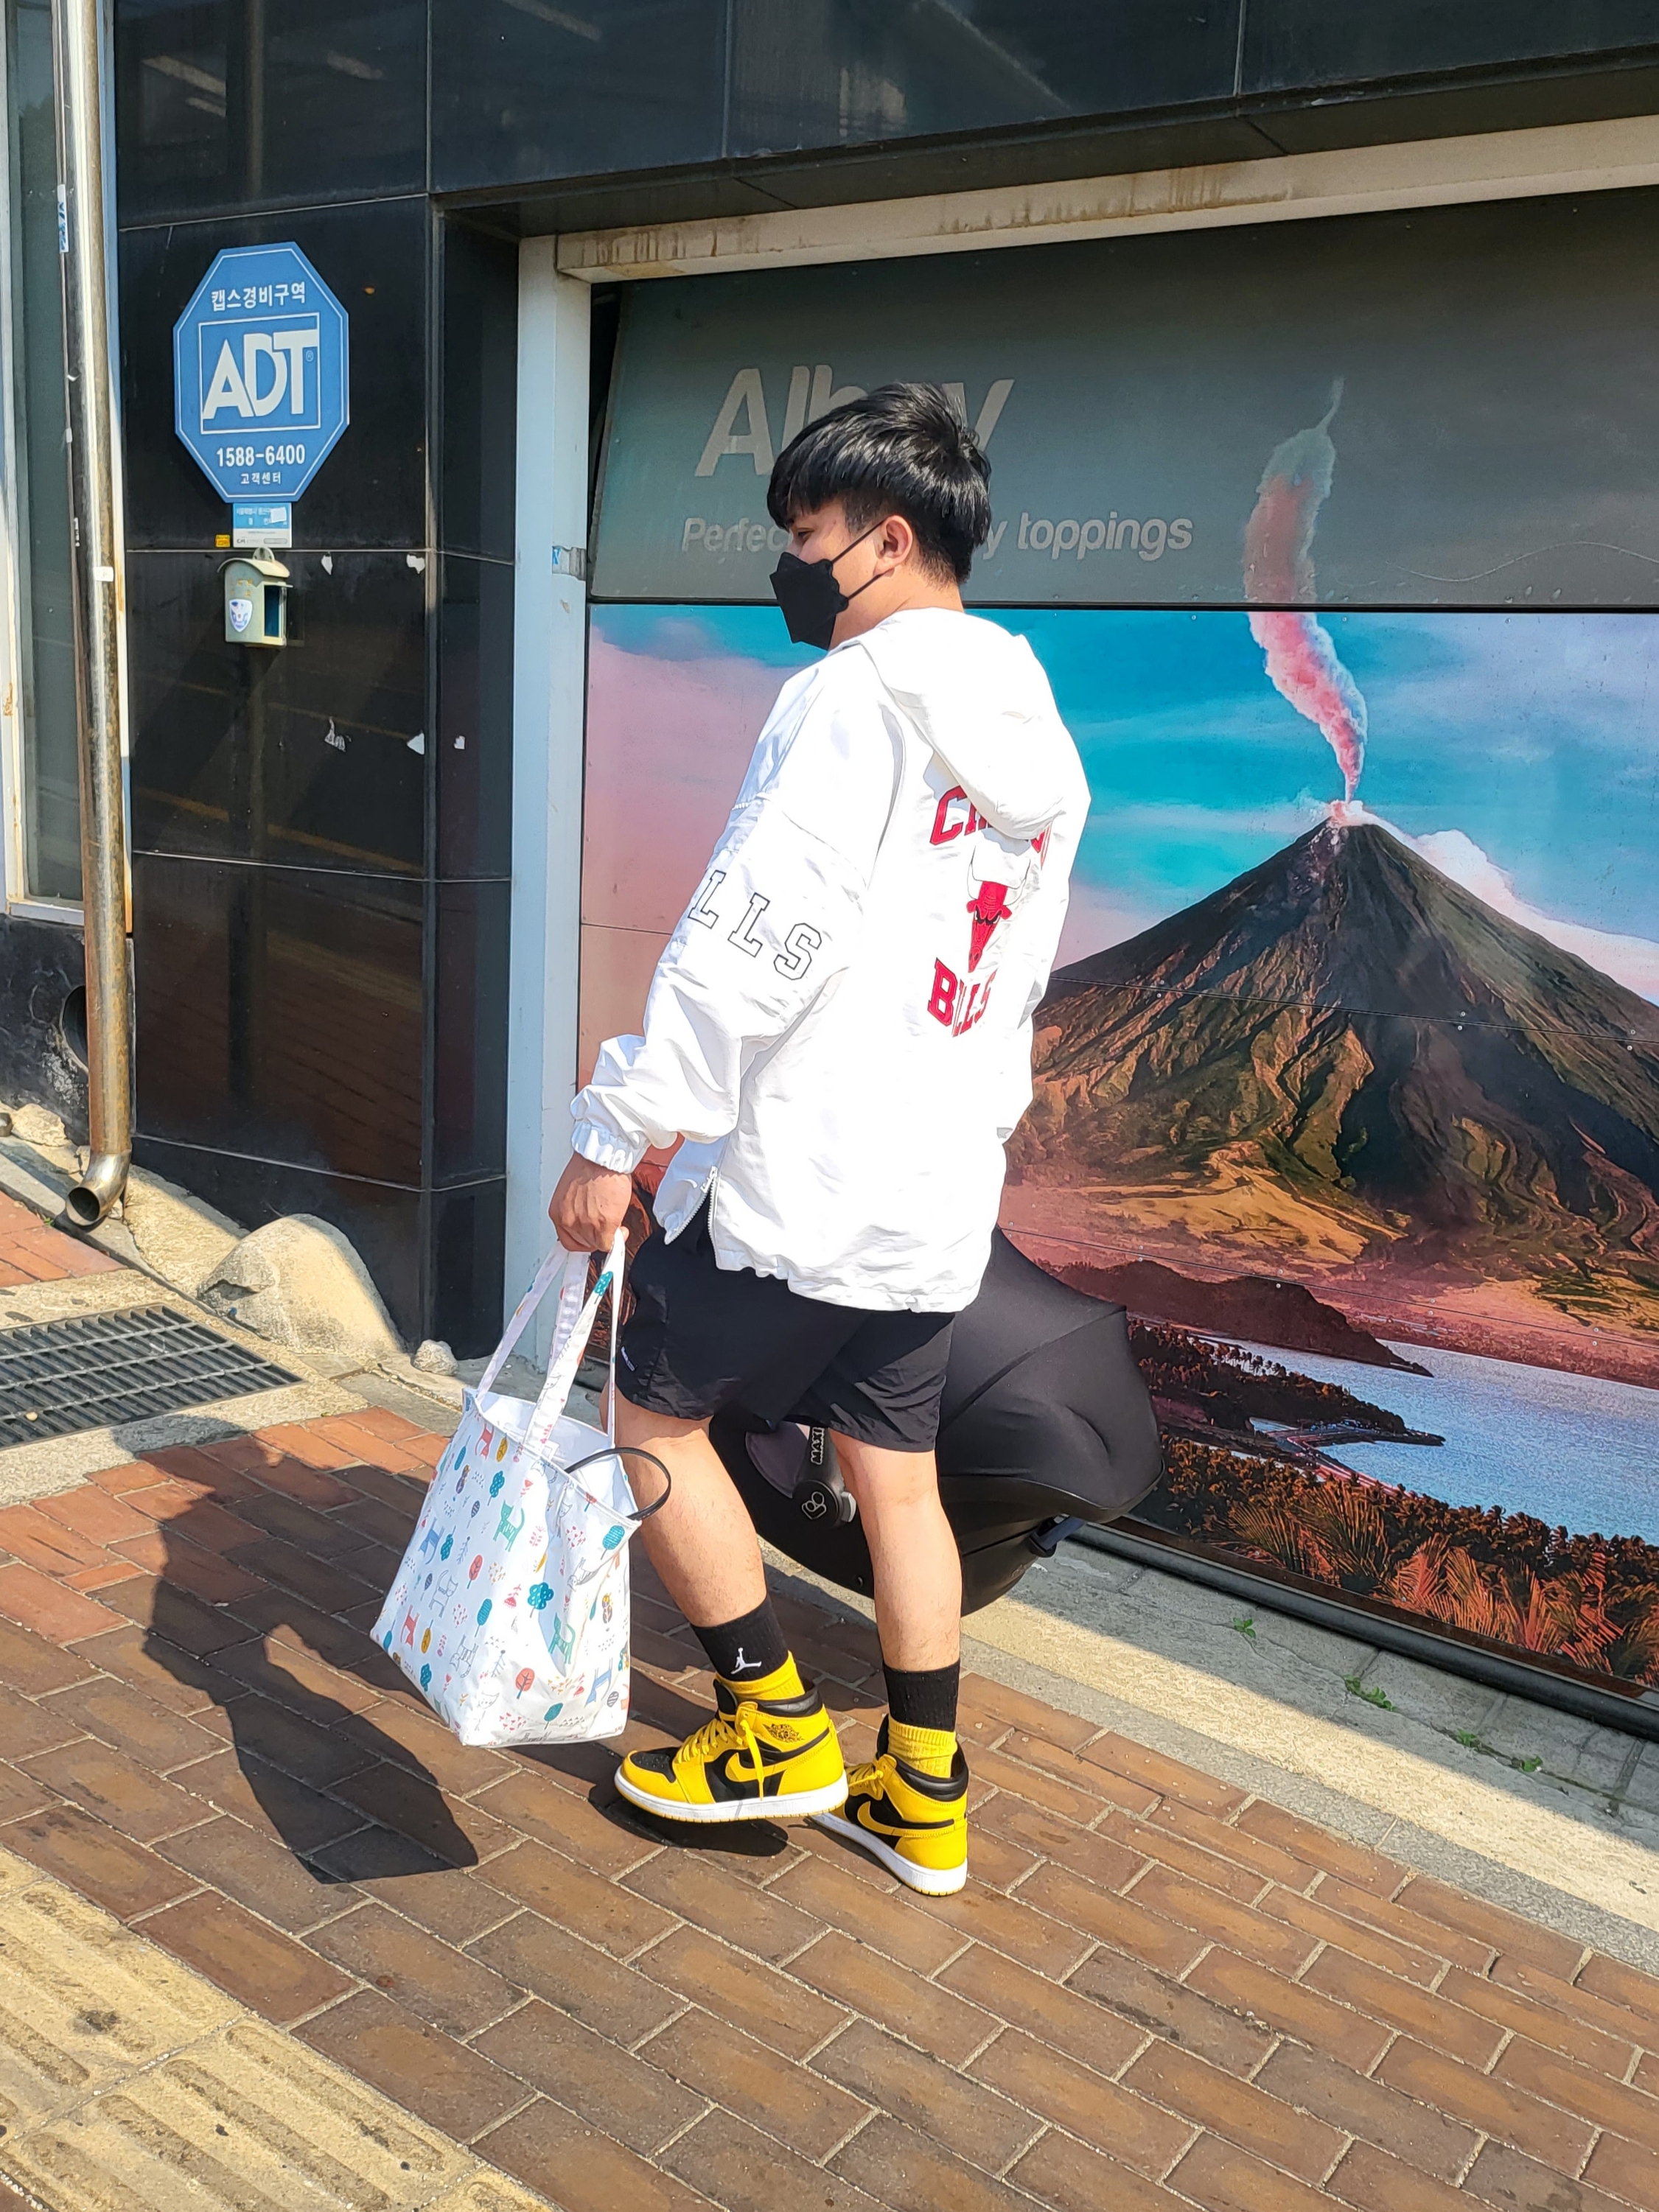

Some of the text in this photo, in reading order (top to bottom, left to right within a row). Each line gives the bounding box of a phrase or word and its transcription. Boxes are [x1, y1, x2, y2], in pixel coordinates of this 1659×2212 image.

[211, 281, 305, 312] 캡스경비구역
[203, 329, 318, 420] ADT
[216, 444, 305, 467] 1588-6400
[240, 471, 281, 485] 고객센터
[681, 517, 794, 552] Perfec
[1017, 511, 1193, 561] toppings
